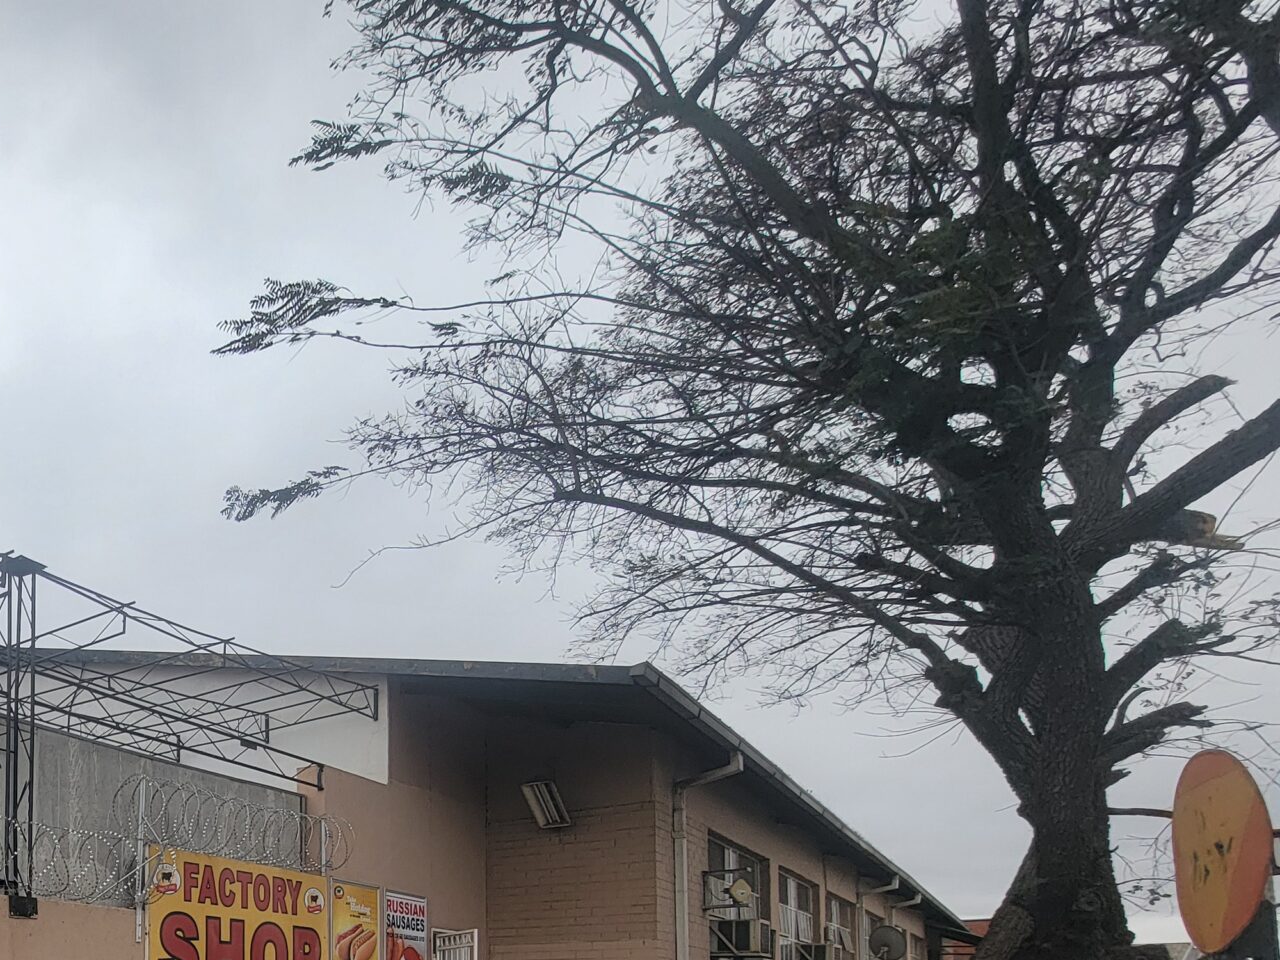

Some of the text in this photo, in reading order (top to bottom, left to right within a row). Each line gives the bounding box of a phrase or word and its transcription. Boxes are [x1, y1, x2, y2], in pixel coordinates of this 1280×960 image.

[183, 861, 303, 916] FACTORY
[386, 899, 425, 918] RUSSIAN
[386, 913, 425, 932] SAUSAGES
